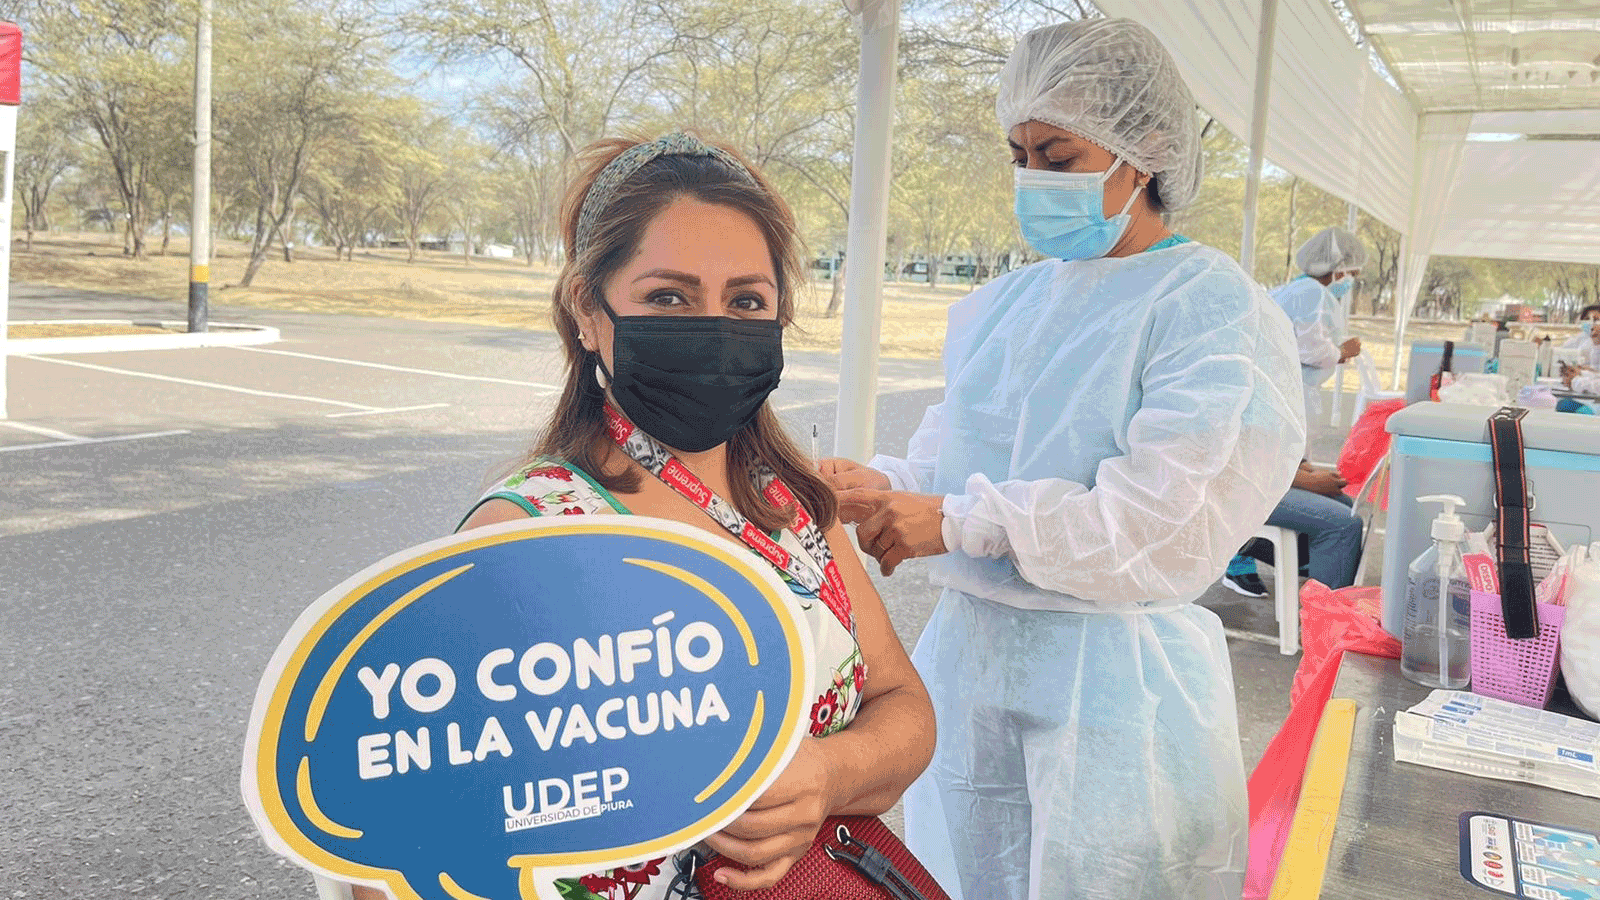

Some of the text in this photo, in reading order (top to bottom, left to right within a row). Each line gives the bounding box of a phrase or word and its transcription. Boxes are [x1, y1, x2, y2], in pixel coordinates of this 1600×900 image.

[667, 465, 708, 504] Supreme
[746, 528, 785, 565] Supreme
[357, 610, 724, 720] YO CONFÍO
[357, 682, 731, 780] EN LA VACUNA
[503, 766, 630, 818] UDEP
[506, 799, 634, 830] UNIVERSIDAD DE PIURA
